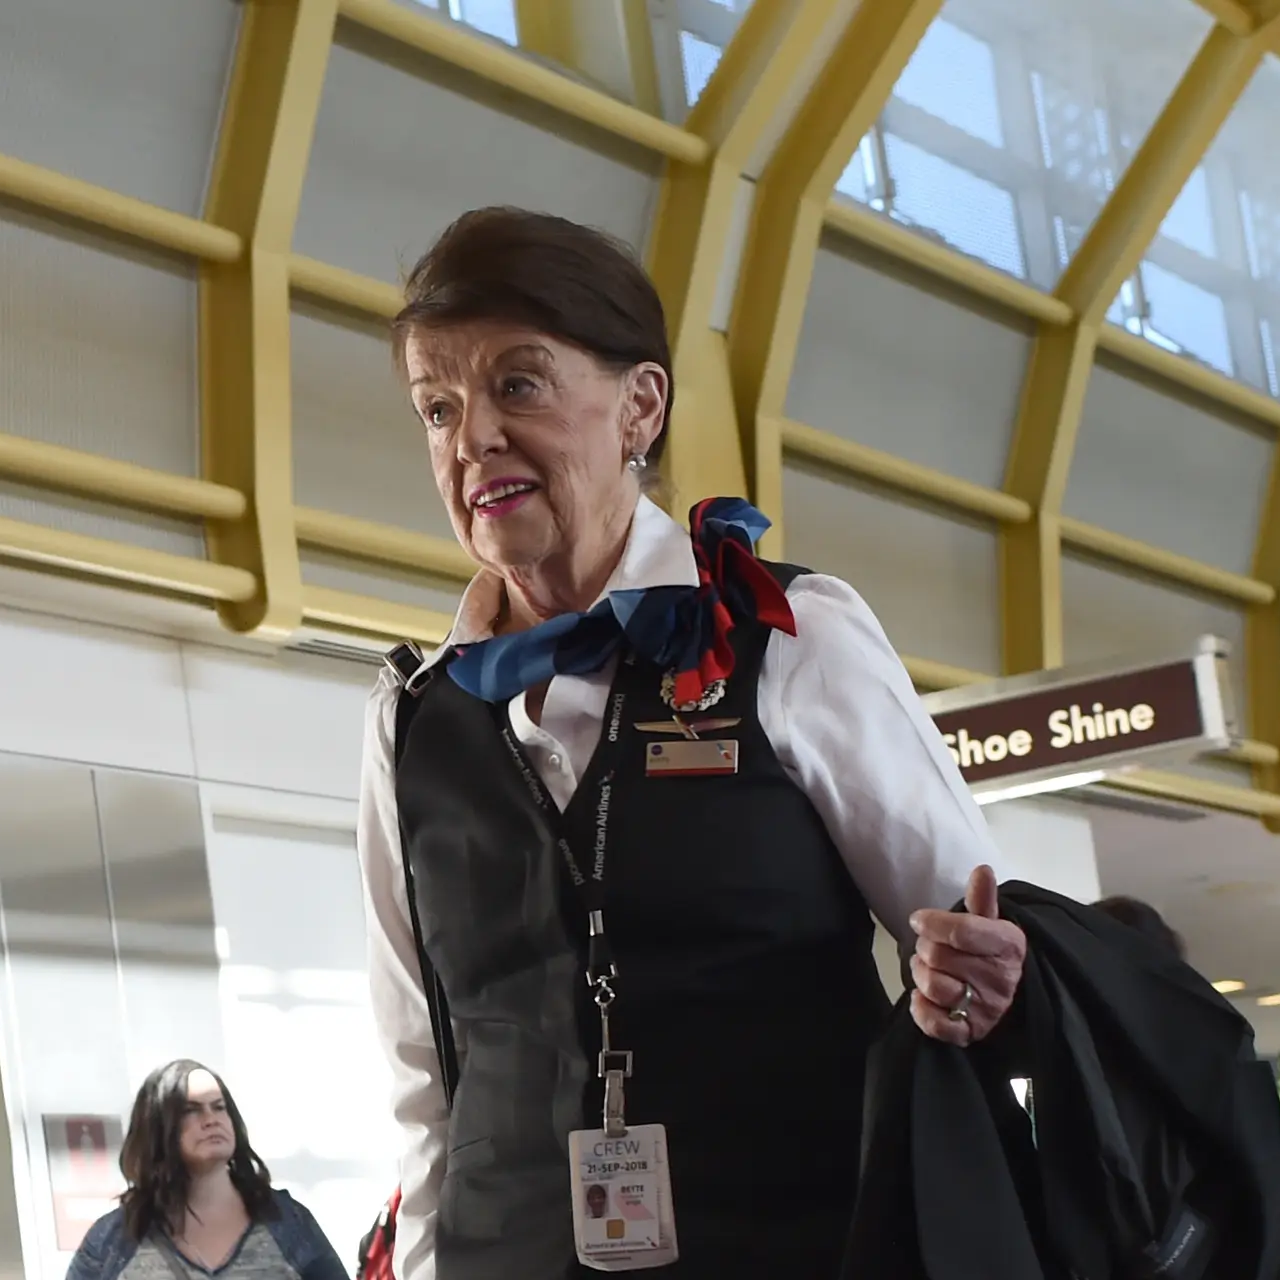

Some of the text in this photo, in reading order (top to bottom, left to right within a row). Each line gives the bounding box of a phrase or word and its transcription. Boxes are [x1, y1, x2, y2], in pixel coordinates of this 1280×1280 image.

[942, 702, 1155, 768] Shoe Shine
[592, 785, 612, 881] American Airlines
[593, 1140, 640, 1157] CREW
